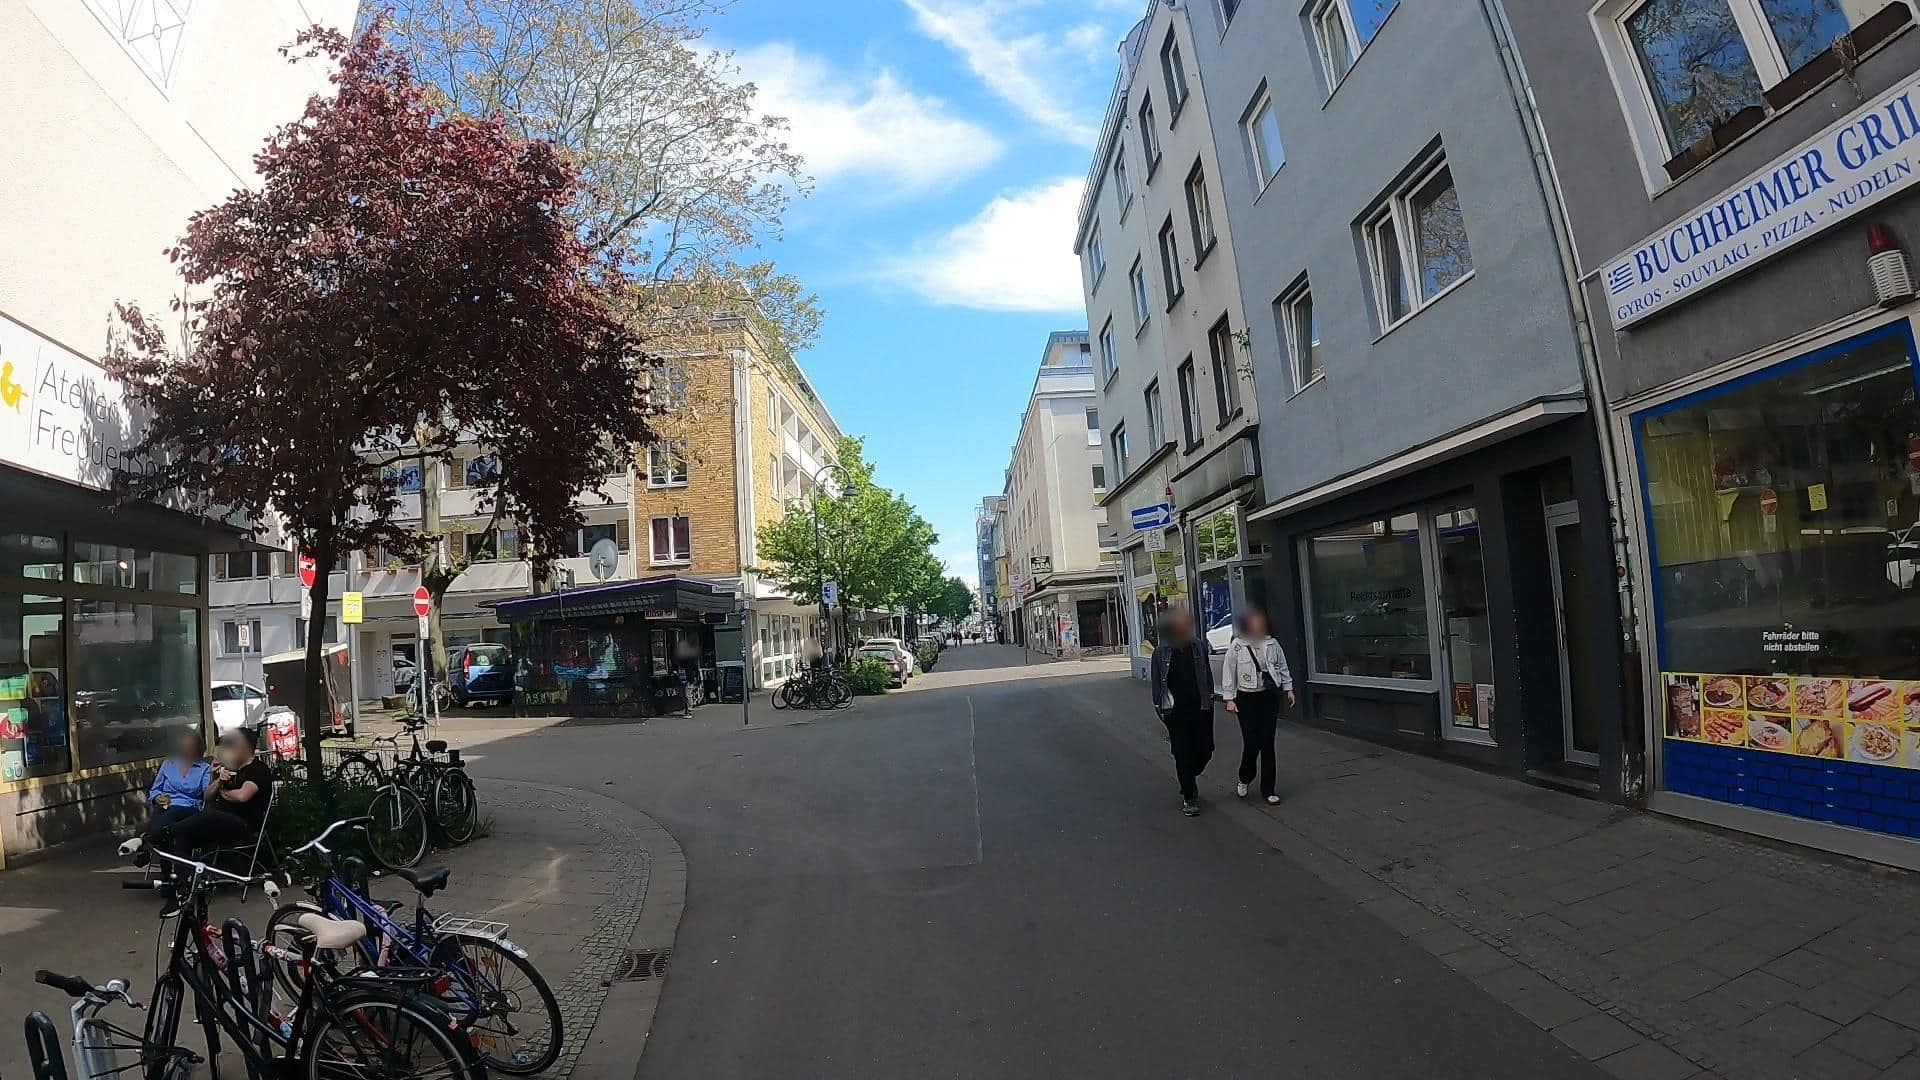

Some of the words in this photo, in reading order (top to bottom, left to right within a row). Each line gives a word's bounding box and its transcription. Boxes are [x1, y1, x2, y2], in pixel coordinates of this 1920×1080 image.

[1634, 148, 1835, 284] BUCHHEIMER
[1836, 84, 1920, 170] GRIL
[1617, 288, 1662, 321] GYROS
[1672, 243, 1750, 293] SOUVLAKI
[1762, 211, 1816, 248] PIZZA
[1829, 156, 1911, 210] NUDELN
[39, 361, 117, 422] Atelier
[1763, 631, 1800, 641] Fahrräder
[1801, 631, 1820, 641] bitte
[1763, 642, 1783, 652] nicht
[1784, 642, 1820, 652] abstellen
